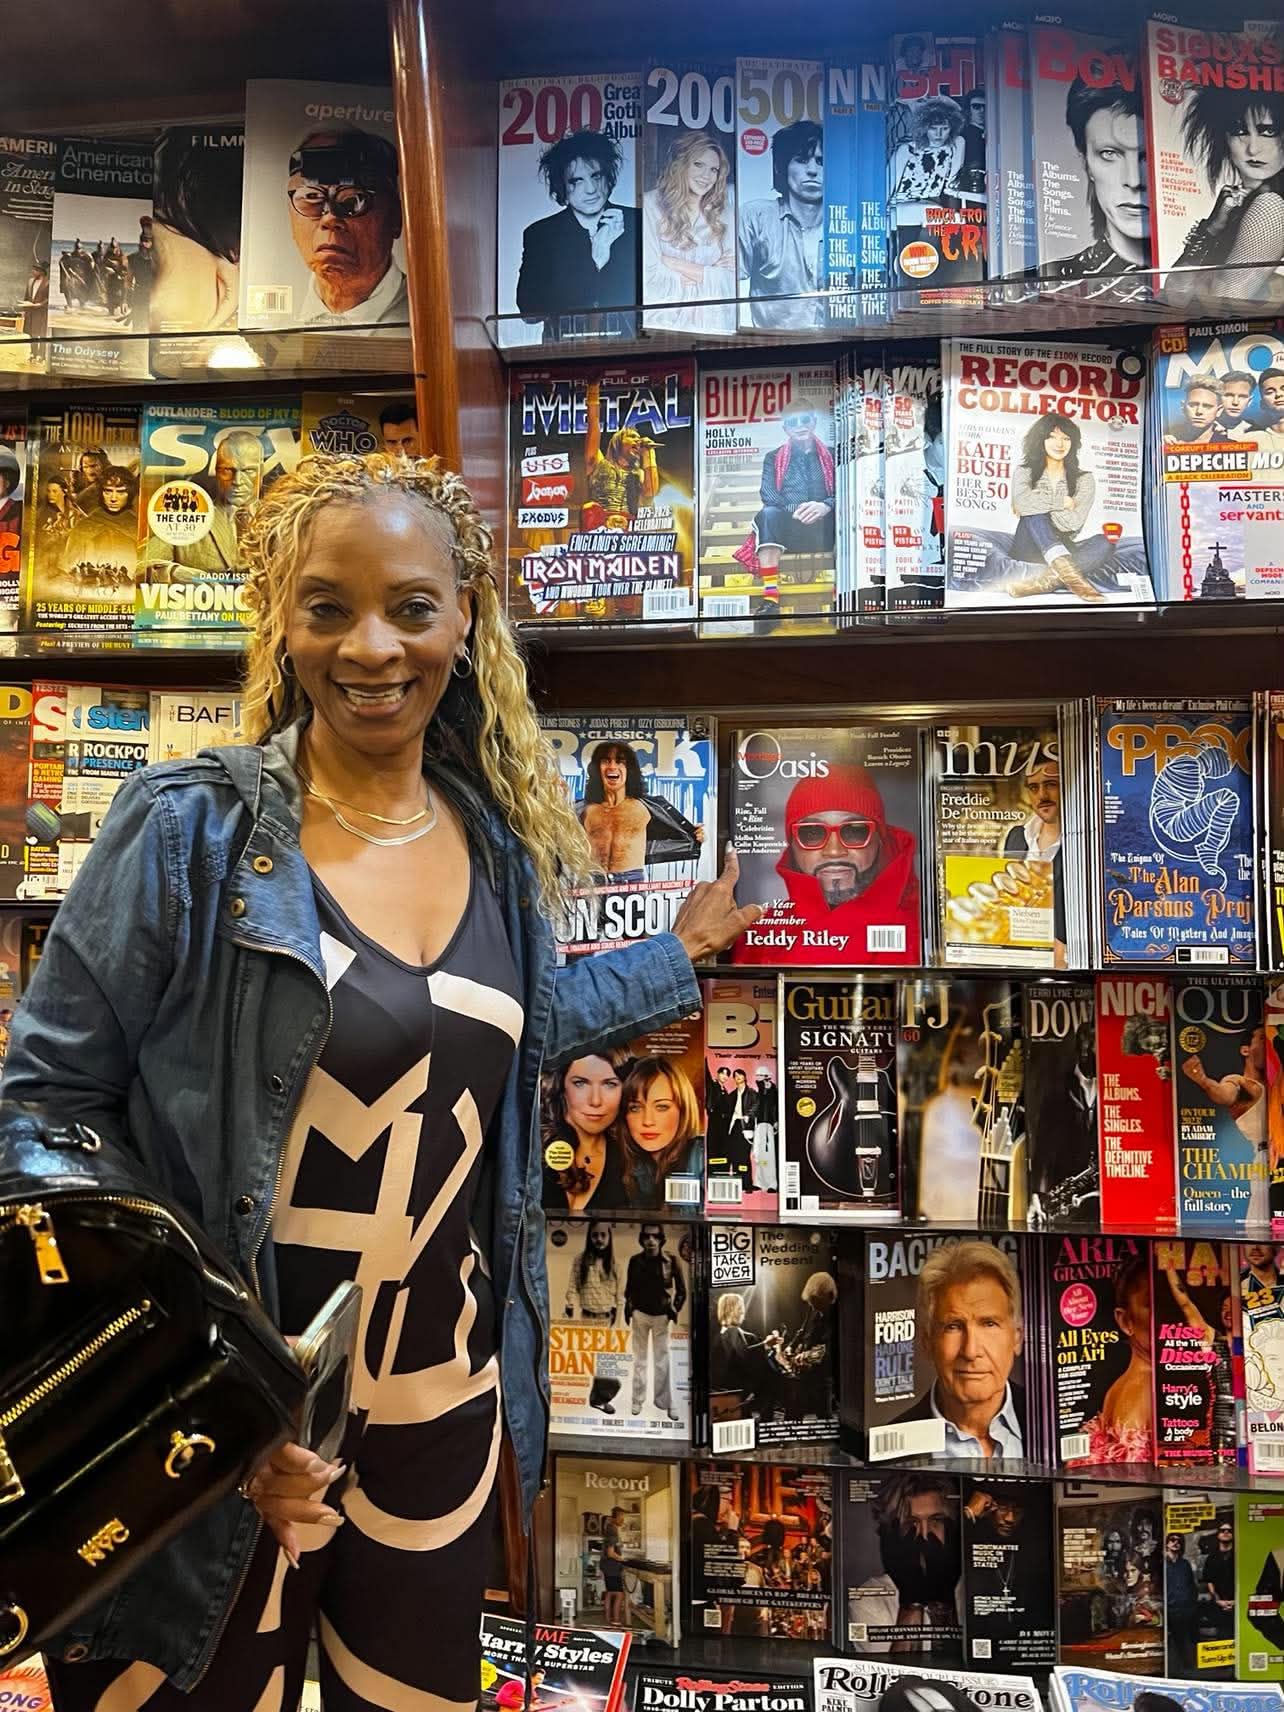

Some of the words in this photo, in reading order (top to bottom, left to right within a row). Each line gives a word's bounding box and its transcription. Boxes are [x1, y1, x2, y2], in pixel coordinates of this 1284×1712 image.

[305, 103, 395, 122] aperture
[1188, 326, 1215, 337] PAUL
[1215, 322, 1249, 336] SIMON
[960, 342, 974, 353] THE
[976, 343, 994, 355] FULL
[996, 345, 1022, 357] STORY
[1024, 347, 1036, 358] OF
[1037, 348, 1051, 360] THE
[1080, 352, 1113, 365] RECORD
[1161, 337, 1187, 353] CD!
[960, 354, 1141, 400] RECORD
[705, 371, 792, 424] Blitzed
[957, 387, 1140, 425] COLLECTOR
[309, 429, 378, 454] WHO
[706, 428, 736, 440] HOLLY
[706, 437, 752, 449] JOHNSON
[957, 440, 1011, 461] KATE
[956, 458, 1011, 478] BUSH
[1166, 453, 1249, 471] DEPECHE
[957, 477, 983, 489] HER
[957, 487, 985, 500] BEST
[986, 481, 1009, 500] 50
[955, 498, 998, 511] SONGS
[157, 513, 175, 523] THE
[176, 513, 207, 524] CRAFT
[571, 534, 619, 551] ENGLAND'S
[620, 533, 677, 551] SCREAMING!
[524, 557, 583, 584] IRON
[584, 554, 679, 583] MAIDEN
[36, 603, 48, 613] 25
[49, 603, 74, 614] YEARS
[587, 730, 645, 740] CLASSIC
[737, 732, 831, 779] Oasis
[941, 793, 992, 806] Freddie
[941, 807, 961, 821] De
[962, 807, 1027, 821] Tommaso
[1128, 866, 1156, 884] The
[1154, 866, 1200, 897] Alan
[772, 898, 797, 910] Year
[1108, 888, 1195, 926] Parsons
[745, 929, 799, 951] Teddy
[802, 929, 850, 952] Riley
[1102, 1073, 1121, 1088] THE
[1103, 1087, 1143, 1101] ALBUMS.
[1104, 1105, 1122, 1119] THE
[1104, 1118, 1145, 1133] SINGLES.
[1104, 1136, 1123, 1151] THE
[1105, 1150, 1153, 1165] DEFINITIVE
[1182, 1147, 1220, 1163] THE
[1106, 1164, 1150, 1179] TIMELINE.
[1183, 1186, 1222, 1200] Queen
[1231, 1186, 1251, 1199] the
[1184, 1198, 1204, 1212] full
[1205, 1201, 1233, 1216] story
[713, 1231, 751, 1252] BIG
[759, 1230, 785, 1242] The
[875, 1309, 916, 1322] HARRISON
[549, 1326, 633, 1353] STEELY
[875, 1319, 916, 1345] FORD
[1057, 1331, 1080, 1349] All
[1081, 1328, 1120, 1346] Eyes
[1160, 1322, 1208, 1341] Kiss
[1057, 1350, 1077, 1364] on
[1079, 1343, 1105, 1362] Ari
[549, 1351, 596, 1377] DAN
[875, 1353, 914, 1378] RULE
[1162, 1383, 1199, 1396] Harry's
[1164, 1390, 1203, 1410] style
[1161, 1417, 1200, 1429] Tattoos
[583, 1471, 653, 1495] Record
[544, 1644, 615, 1666] Styles
[643, 1686, 711, 1712] Dolly
[714, 1690, 805, 1712] Parton
